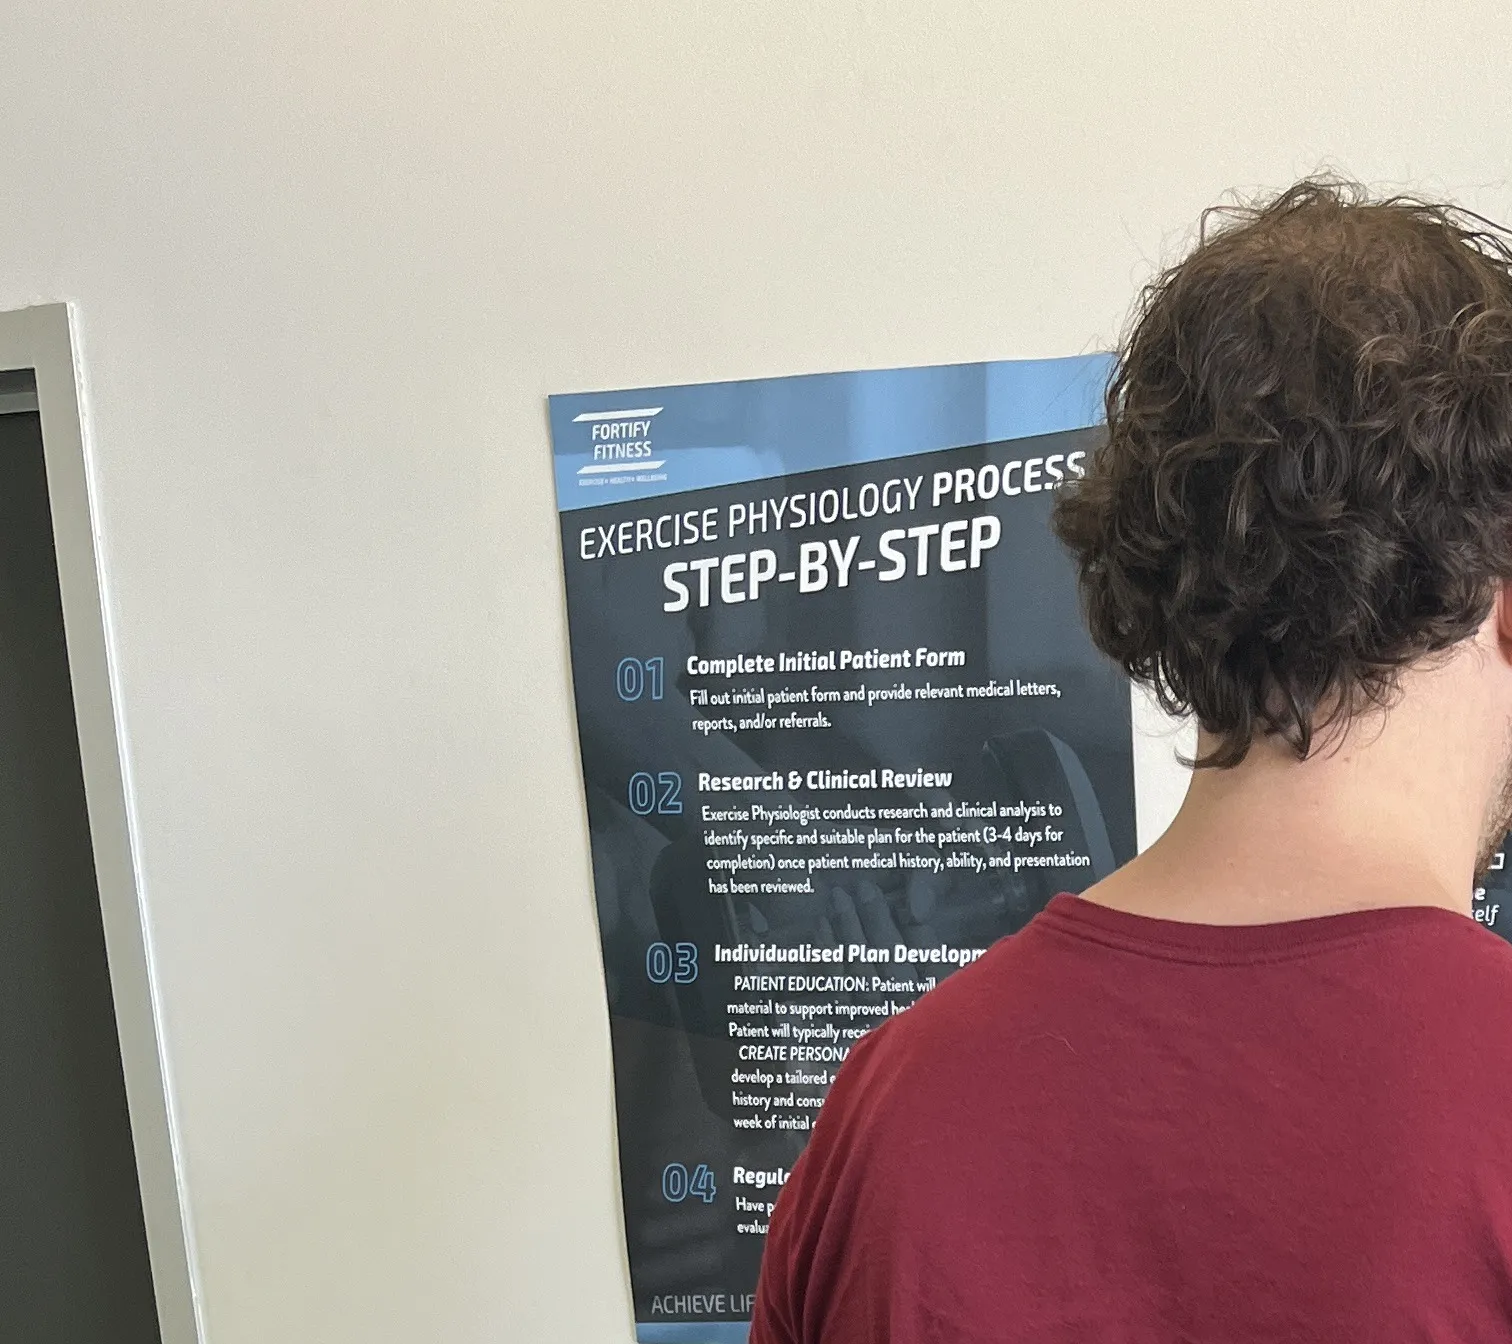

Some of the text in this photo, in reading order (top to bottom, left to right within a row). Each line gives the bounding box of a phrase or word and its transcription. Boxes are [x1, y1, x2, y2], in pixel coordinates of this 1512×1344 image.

[592, 421, 651, 440] FORTIFY
[594, 441, 652, 460] FITNESS
[581, 508, 718, 559] EXERCISE
[729, 476, 923, 537] PHYSIOLOGY
[662, 515, 1001, 613] STEP-BY-STEP
[616, 648, 965, 701] 01 Complete Initial Patient Form
[690, 680, 1060, 709] Fill out initial patient form and provide relevant medical letters,
[692, 712, 831, 736] reports, and/or referrals.
[628, 768, 952, 815] 02 Research & Clinical Review
[702, 801, 1062, 826] Exercise Physiologist conducts research and clinical analysis to
[704, 826, 1063, 850] identify specific and suitable plan for the patient (3-4 days for
[707, 851, 1090, 874] completion) once patient medical history, ability, and presentation
[709, 878, 814, 893] has been reviewed.
[646, 942, 889, 984] 03 Individualised Plan
[663, 1163, 716, 1203] 04
[652, 1295, 725, 1314] ACHIEVE
